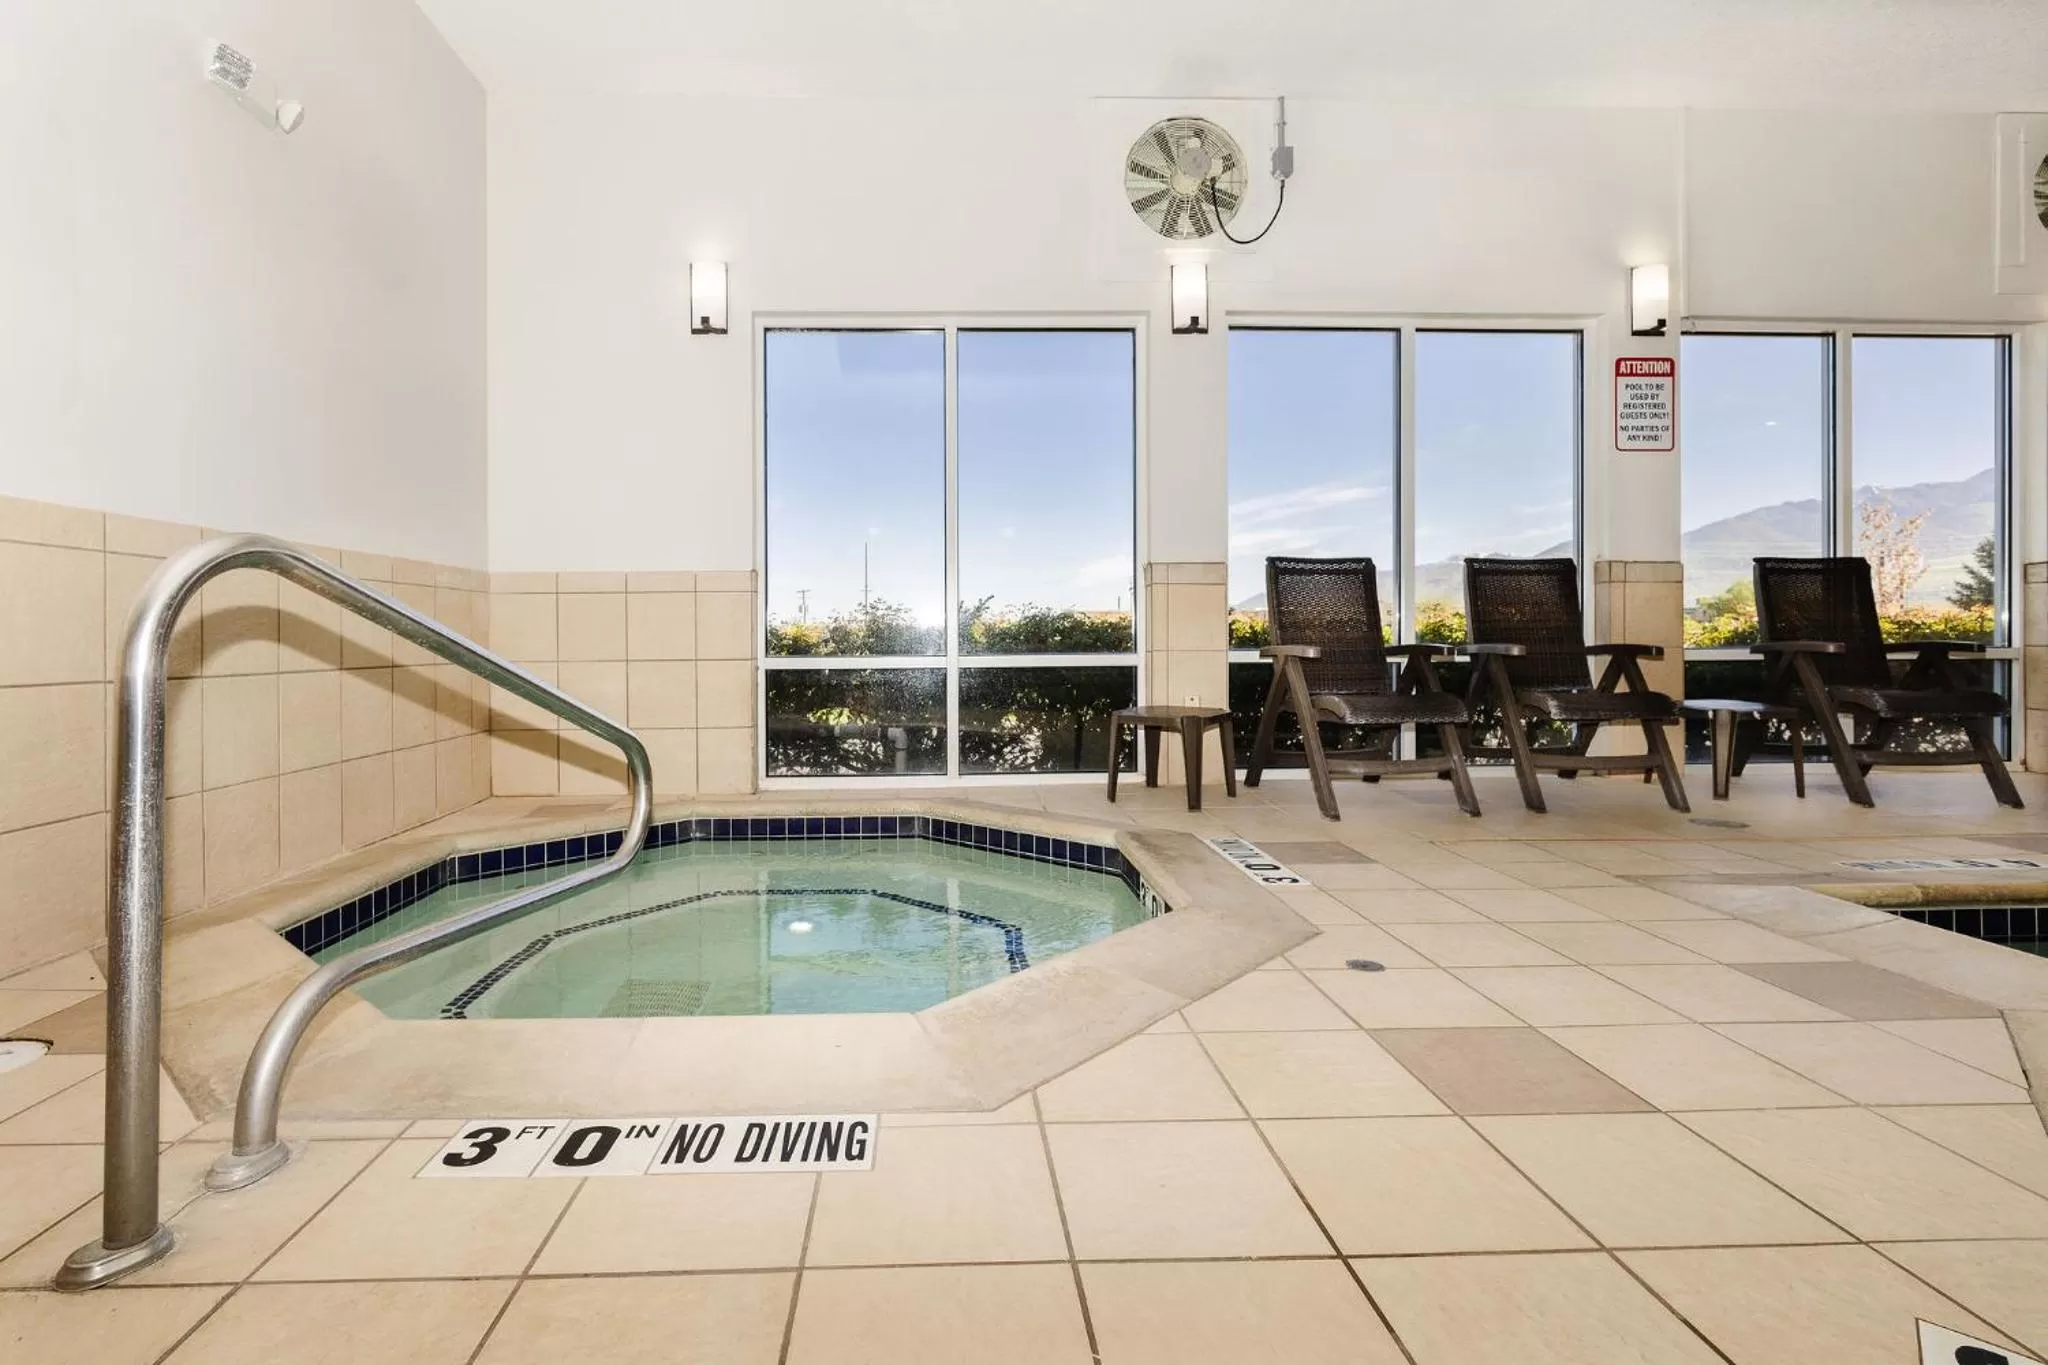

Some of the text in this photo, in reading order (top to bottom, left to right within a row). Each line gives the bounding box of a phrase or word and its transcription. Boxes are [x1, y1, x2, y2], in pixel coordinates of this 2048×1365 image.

[1619, 361, 1671, 374] ATTENTION
[1625, 383, 1665, 391] POOL TO BE
[1623, 402, 1667, 410] REGISTERED
[442, 1120, 869, 1168] 3 FT 0 IN NO DIVING
